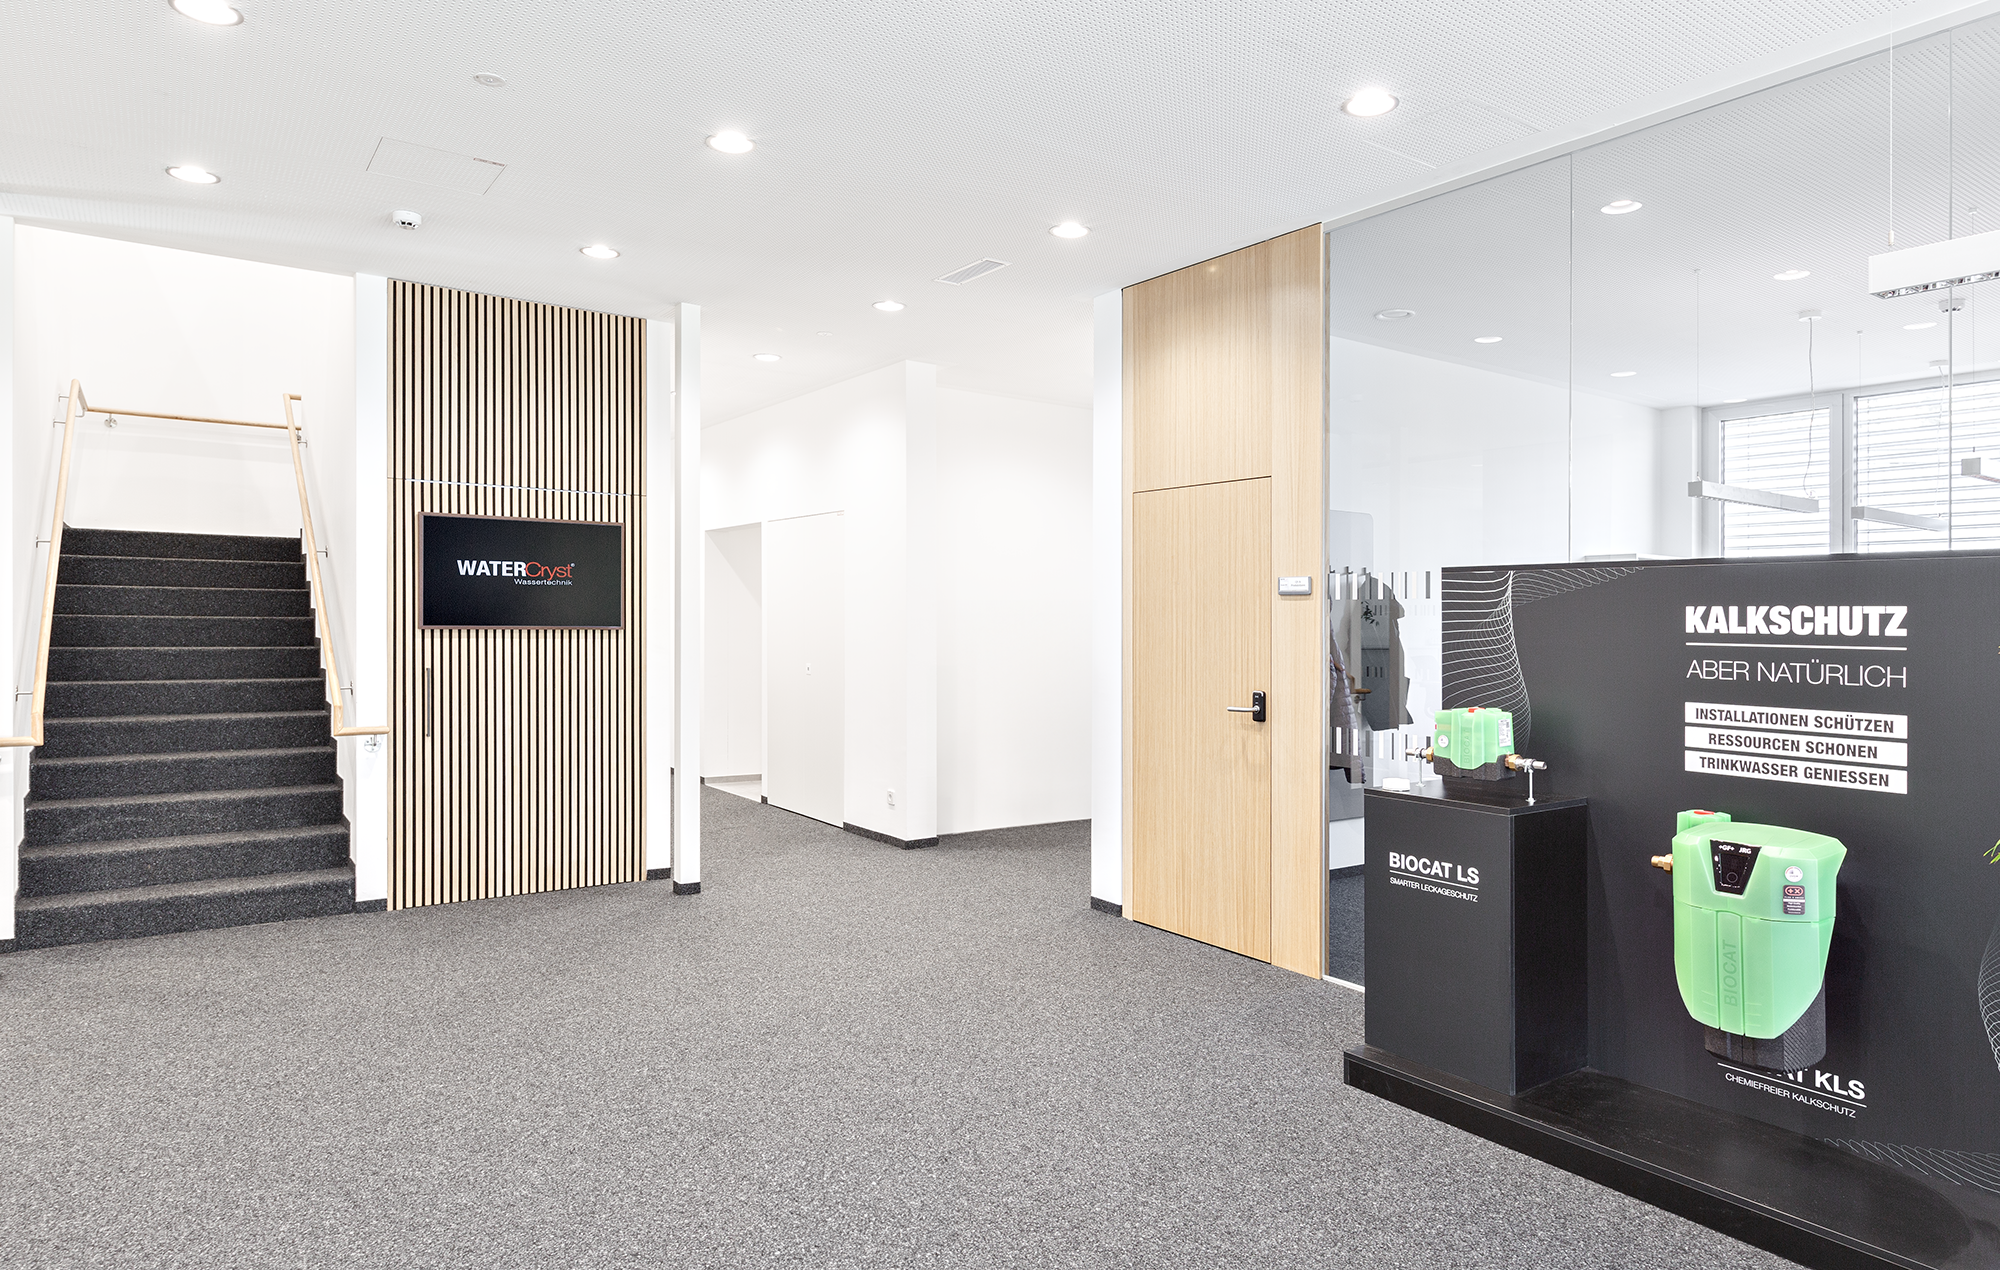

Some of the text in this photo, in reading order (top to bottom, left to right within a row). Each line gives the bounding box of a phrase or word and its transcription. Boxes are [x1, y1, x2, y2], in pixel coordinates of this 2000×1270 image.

[1685, 605, 1908, 637] KALKSCHUTZ
[1686, 658, 1907, 688] ABER NATÜRLICH
[1695, 707, 1895, 734] INSTALLATIONEN SCHÜTZEN
[1708, 732, 1878, 759] RESSOURCEN SCHONEN
[1699, 756, 1890, 787] TRINKWASSER GENIESSEN
[1389, 851, 1480, 885] BIOCAT LS
[1389, 876, 1479, 903] SMARTER LECKAGESCHUTZ
[1722, 939, 1738, 1007] BIOCAT
[1725, 1072, 1791, 1099] CHEMIEFREIER
[1792, 1092, 1857, 1119] KALKSCHUTZ
[1815, 1069, 1866, 1100] KLS
